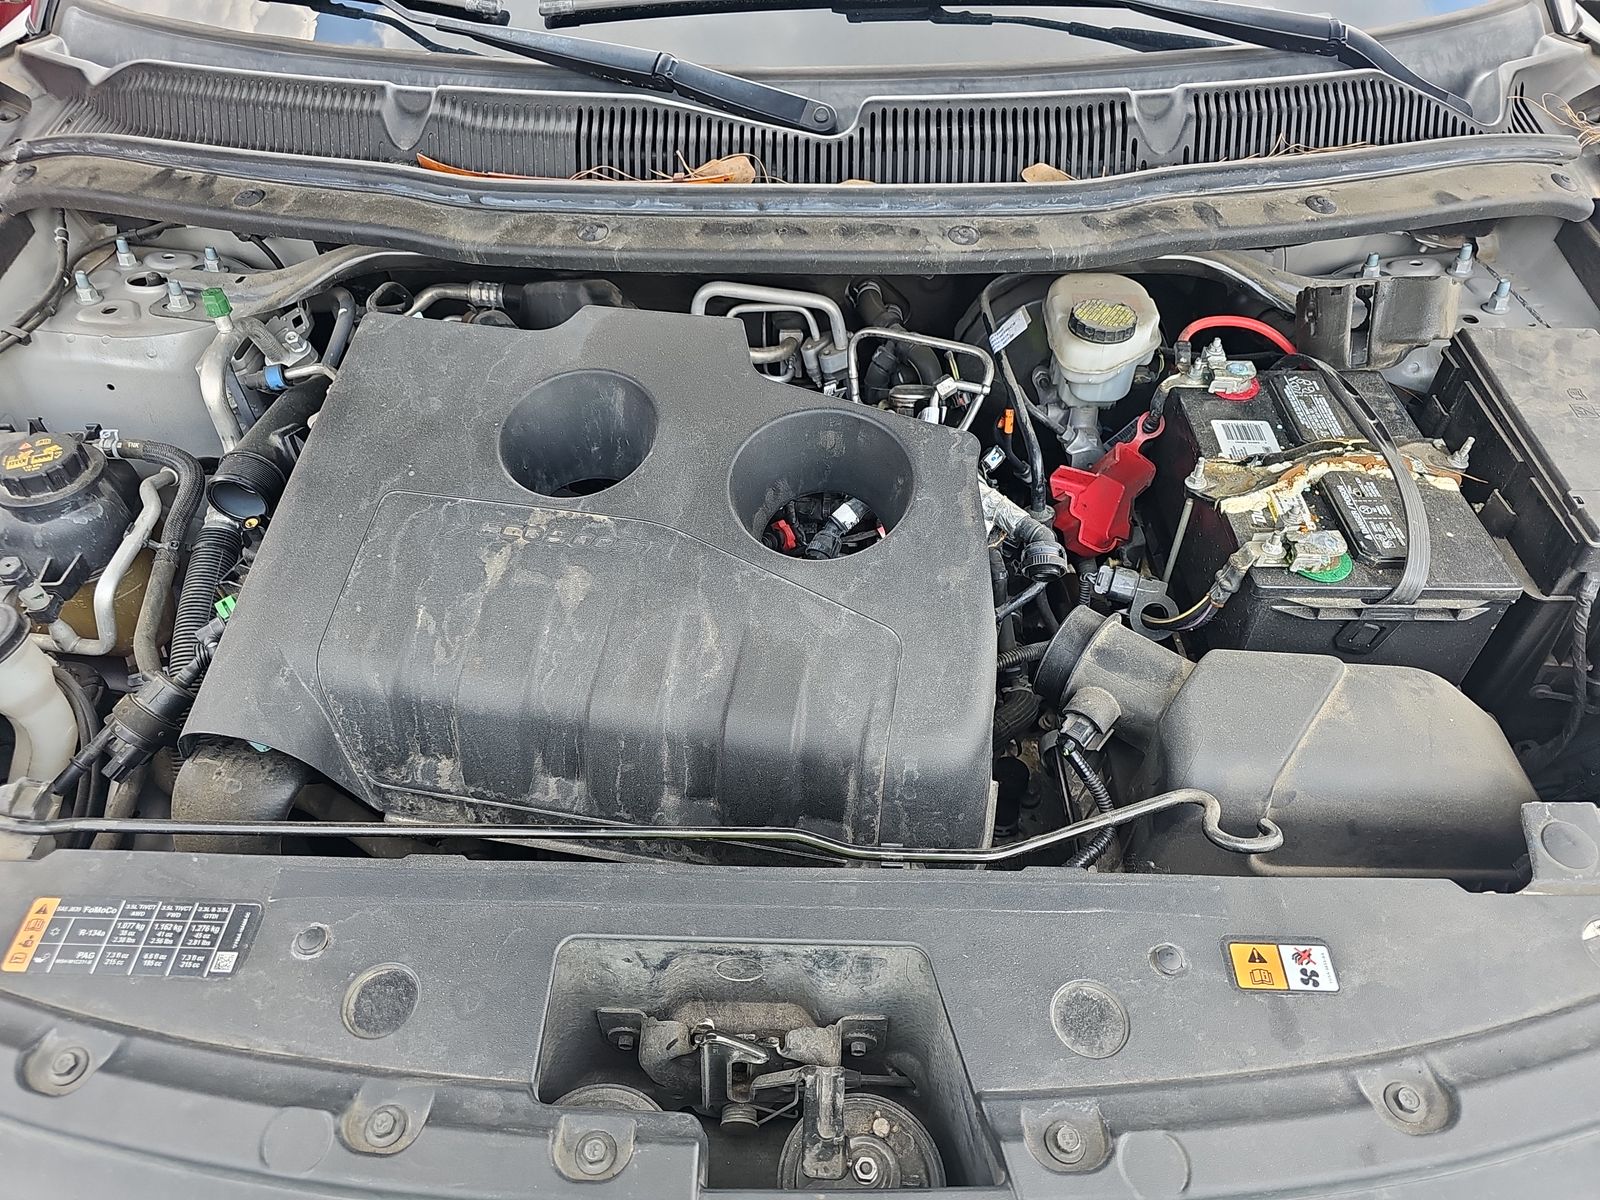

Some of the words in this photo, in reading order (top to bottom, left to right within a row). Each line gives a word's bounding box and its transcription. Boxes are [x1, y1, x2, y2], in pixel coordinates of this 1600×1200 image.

[1337, 485, 1353, 507] POISON
[1351, 509, 1370, 535] DANGER
[83, 905, 118, 914] FoMoCo
[135, 922, 146, 931] kg
[154, 923, 173, 931] 1.162
[172, 924, 183, 933] kg
[191, 924, 210, 932] 1.276
[210, 925, 220, 934] kg
[78, 928, 106, 937] R-134a
[76, 951, 96, 960] PAG
